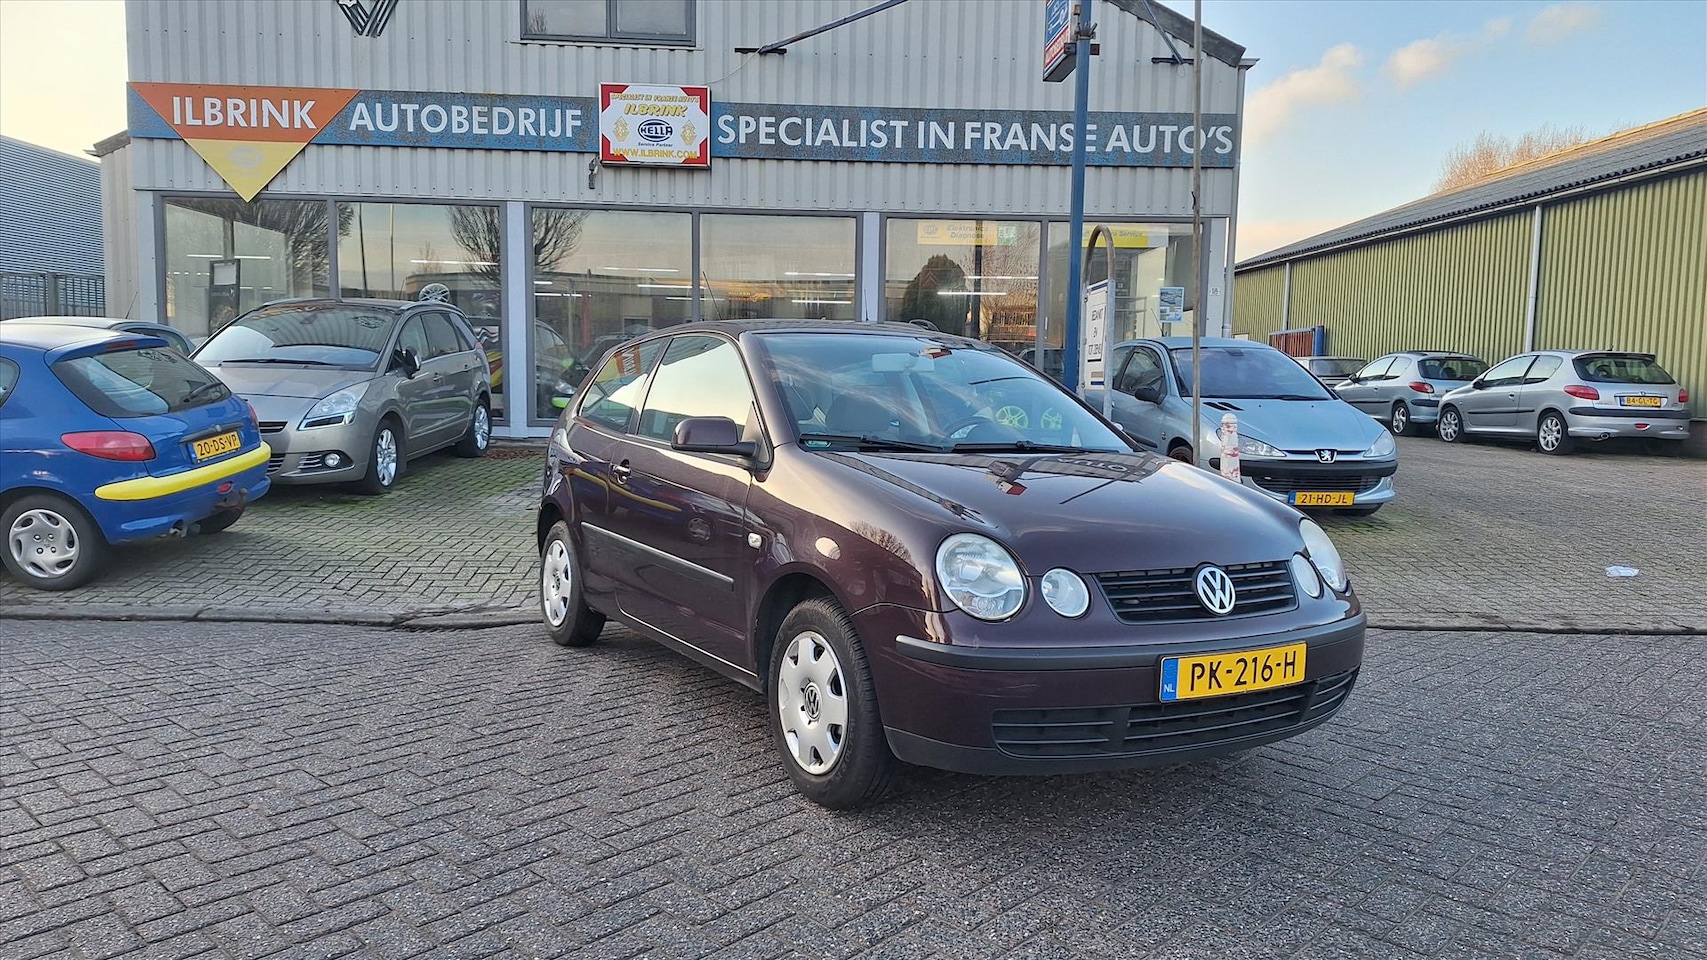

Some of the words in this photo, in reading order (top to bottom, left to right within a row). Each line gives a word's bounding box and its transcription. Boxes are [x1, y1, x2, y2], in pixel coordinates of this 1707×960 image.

[173, 96, 317, 130] ILBRINK
[624, 103, 688, 117] ILBRINK
[349, 101, 582, 138] AUTOBEDRIJF
[640, 126, 673, 136] HELLA
[717, 114, 909, 149] SPECIALIST
[917, 121, 955, 150] IN
[964, 121, 1097, 152] FRANSE
[1105, 124, 1233, 154] AUTO'S
[613, 148, 697, 159] WWW.ILBRINK.COM
[197, 434, 237, 456] 20-DS-VP
[1301, 493, 1348, 504] 21-HD-JL
[1190, 650, 1297, 692] PK-216-H
[1163, 683, 1175, 693] NL
